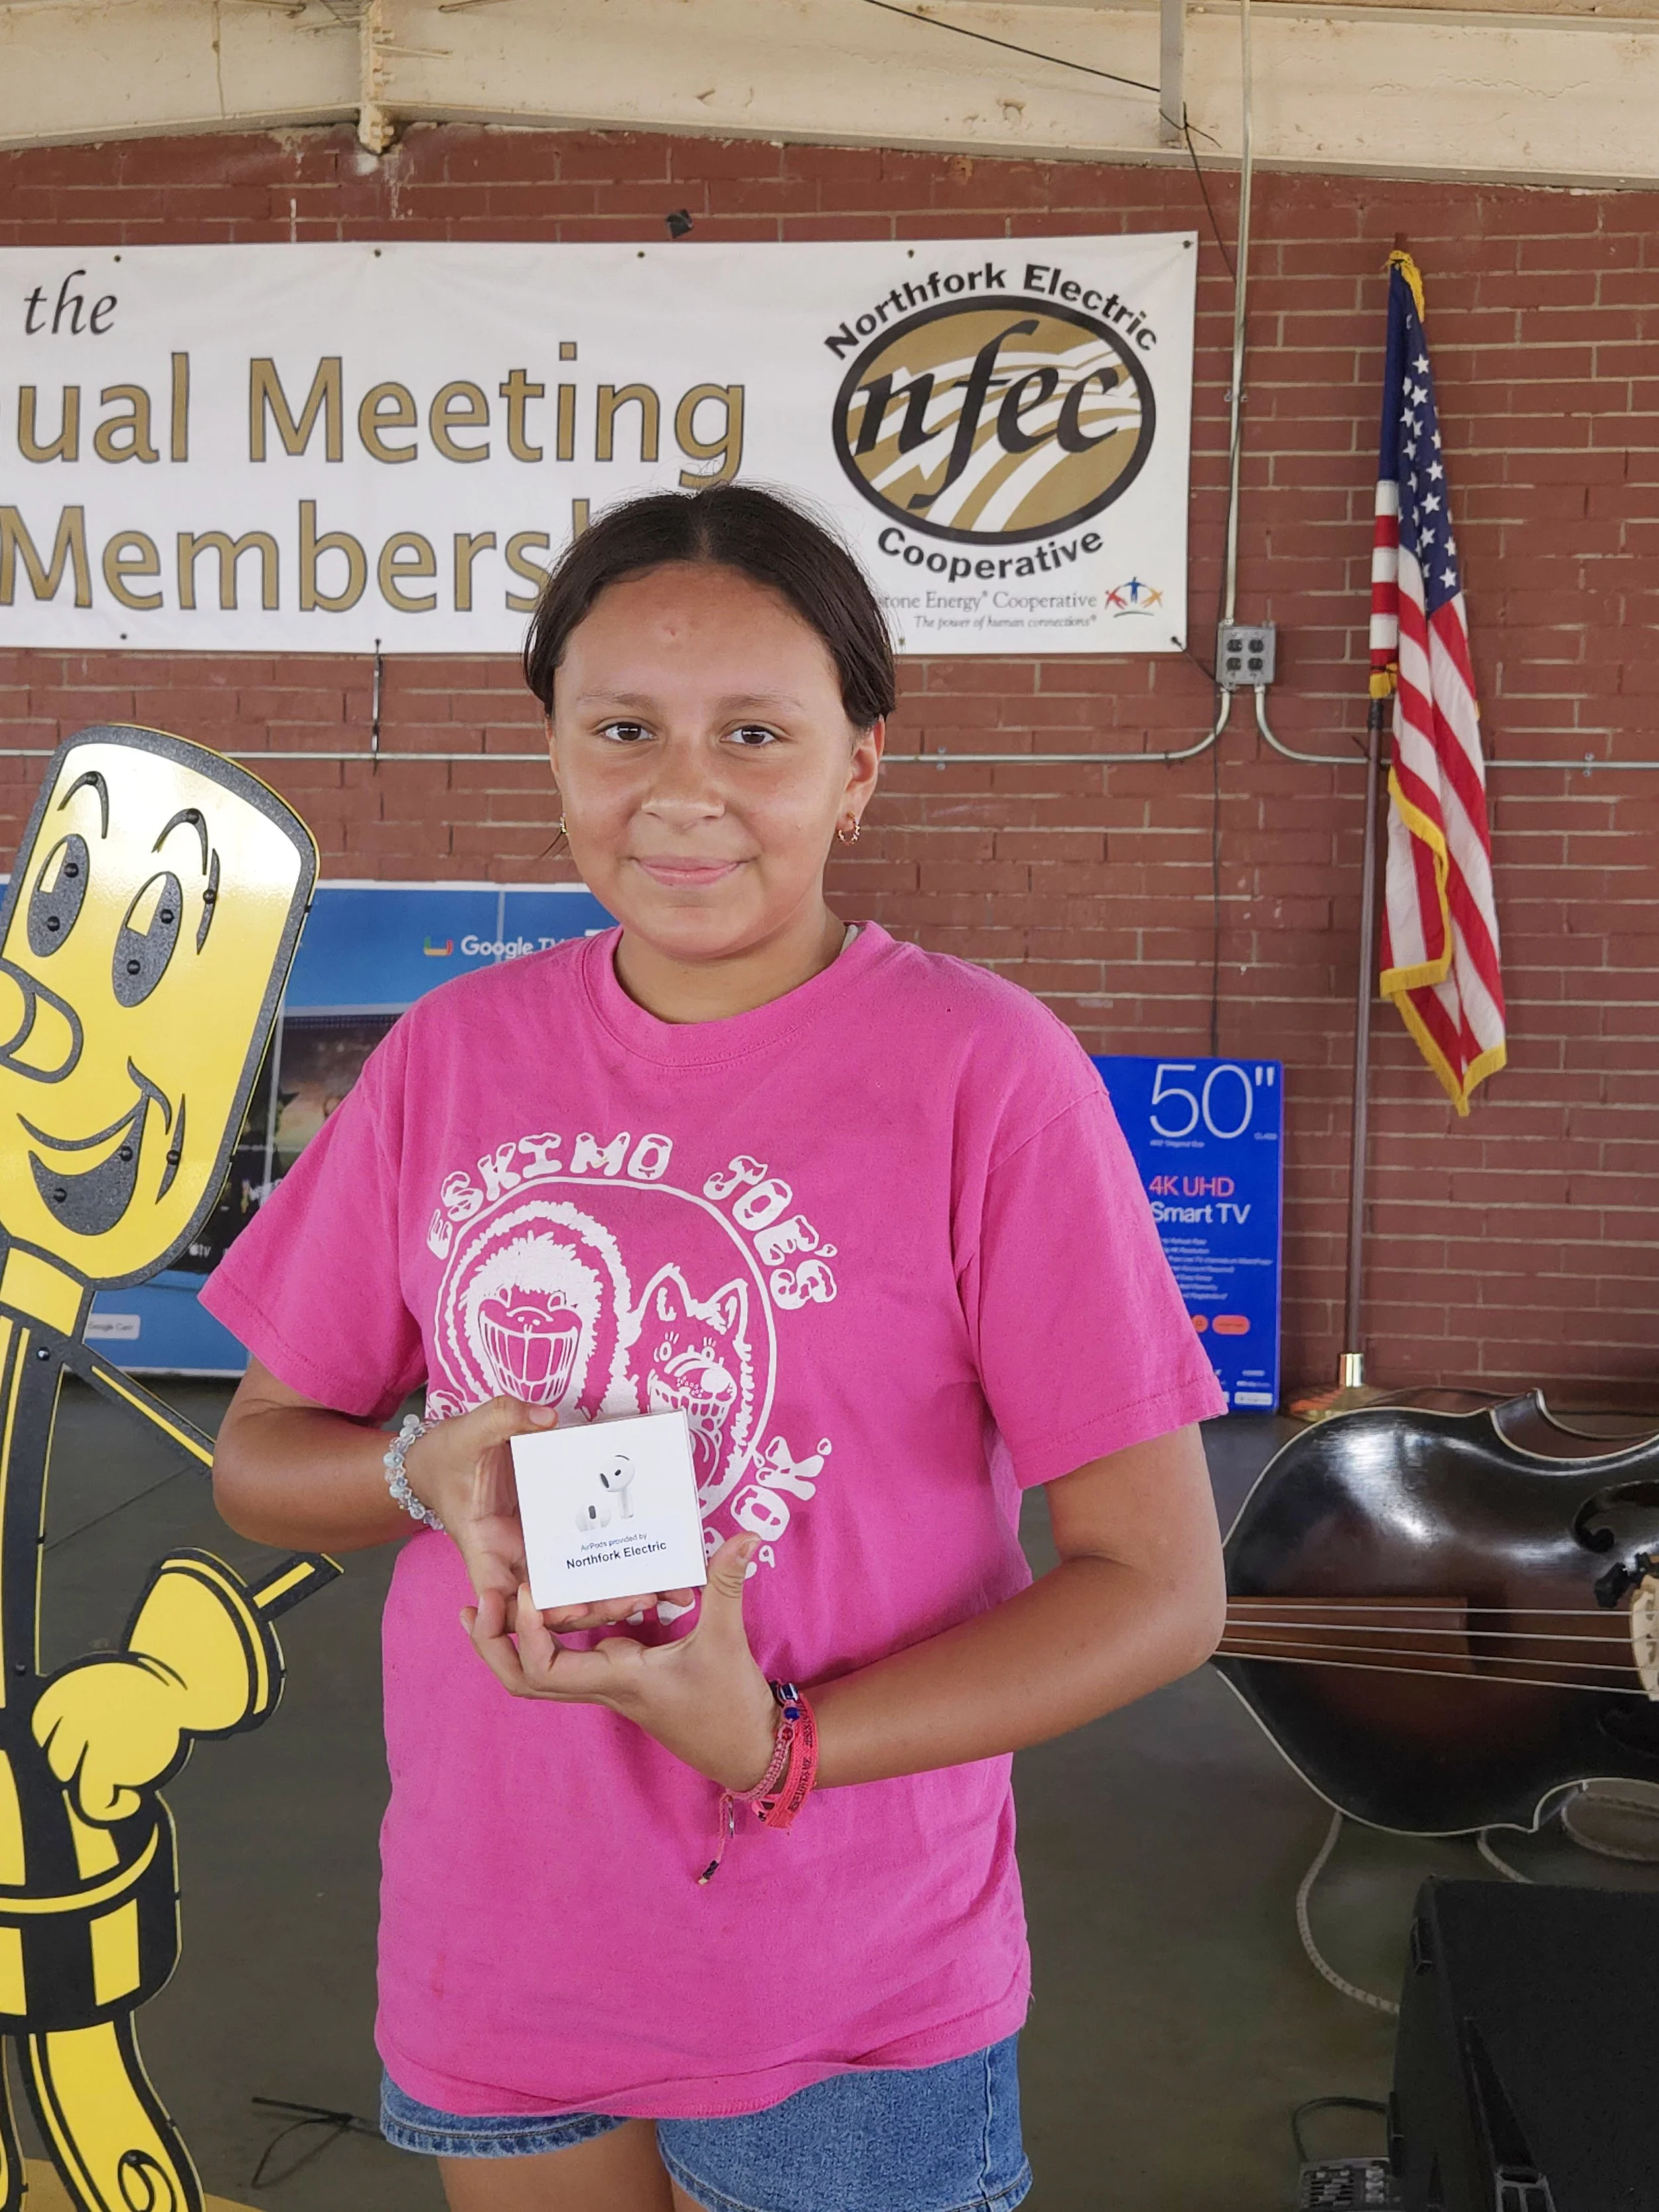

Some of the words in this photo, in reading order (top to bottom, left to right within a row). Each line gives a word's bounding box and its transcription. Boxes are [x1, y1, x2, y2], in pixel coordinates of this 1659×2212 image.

[24, 269, 117, 335] the
[824, 263, 1007, 361] Northfork
[1023, 263, 1157, 352] Electric
[248, 340, 745, 490] Meeting
[854, 319, 1119, 510] nfec
[0, 498, 591, 613] Members
[877, 527, 1104, 583] Cooperative
[914, 614, 935, 628] The
[936, 617, 970, 630] power
[972, 615, 985, 630] of
[987, 615, 1025, 628] human
[992, 591, 1098, 613] Cooperative
[460, 934, 534, 959] Google
[1149, 1175, 1179, 1196] 4K
[1183, 1175, 1235, 1197] UHD
[427, 1132, 673, 1260] ESKIMO
[703, 1155, 837, 1311] JOE'S
[1151, 1201, 1213, 1224] Smart
[1215, 1203, 1252, 1224] TV
[566, 1550, 621, 1570] Northfork
[623, 1540, 667, 1558] Electric
[581, 1540, 607, 1552] AirPods
[609, 1534, 638, 1547] provided
